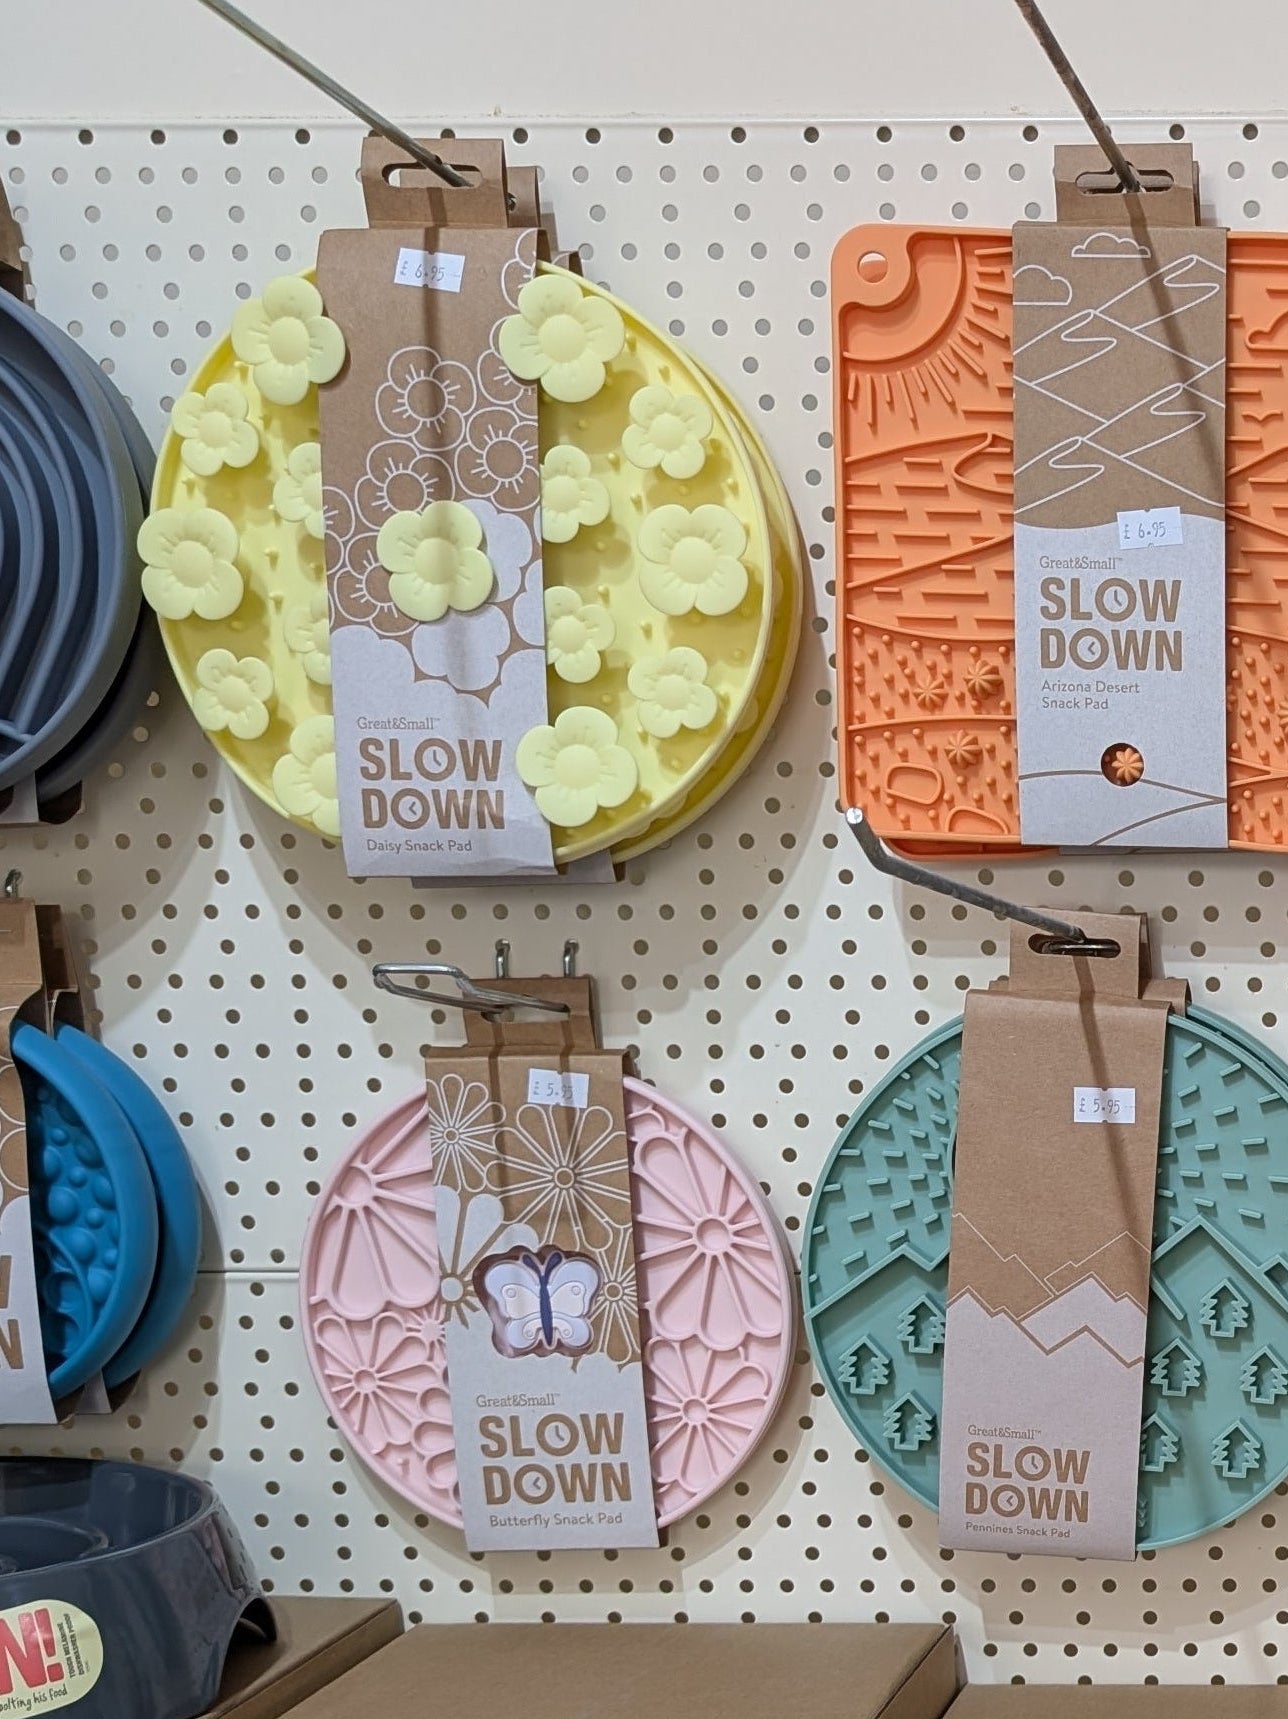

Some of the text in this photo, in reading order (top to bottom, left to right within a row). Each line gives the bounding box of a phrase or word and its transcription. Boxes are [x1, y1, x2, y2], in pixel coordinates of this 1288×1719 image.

[415, 264, 445, 281] 6.95
[1138, 521, 1166, 539] 6.95
[1040, 577, 1182, 622] SLOW
[1040, 628, 1183, 671] DOWN
[1041, 680, 1140, 694] Arizona Desert
[1042, 696, 1109, 710] Snack Pad
[360, 737, 502, 782] SLOW
[361, 788, 505, 830] DOWN
[367, 839, 472, 854] Daisy Snack Pad
[546, 1082, 573, 1099] 5.95
[1093, 1098, 1120, 1114] 5.95
[479, 1412, 624, 1458] SLOW
[966, 1441, 1091, 1484] SLOW
[482, 1462, 632, 1505] DOWN
[965, 1482, 1089, 1522] DOWN
[490, 1512, 622, 1528] Butterfly Snack Pad
[965, 1521, 1070, 1538] Pennines Snack Pad
[33, 1692, 47, 1703] his
[49, 1684, 68, 1700] food
